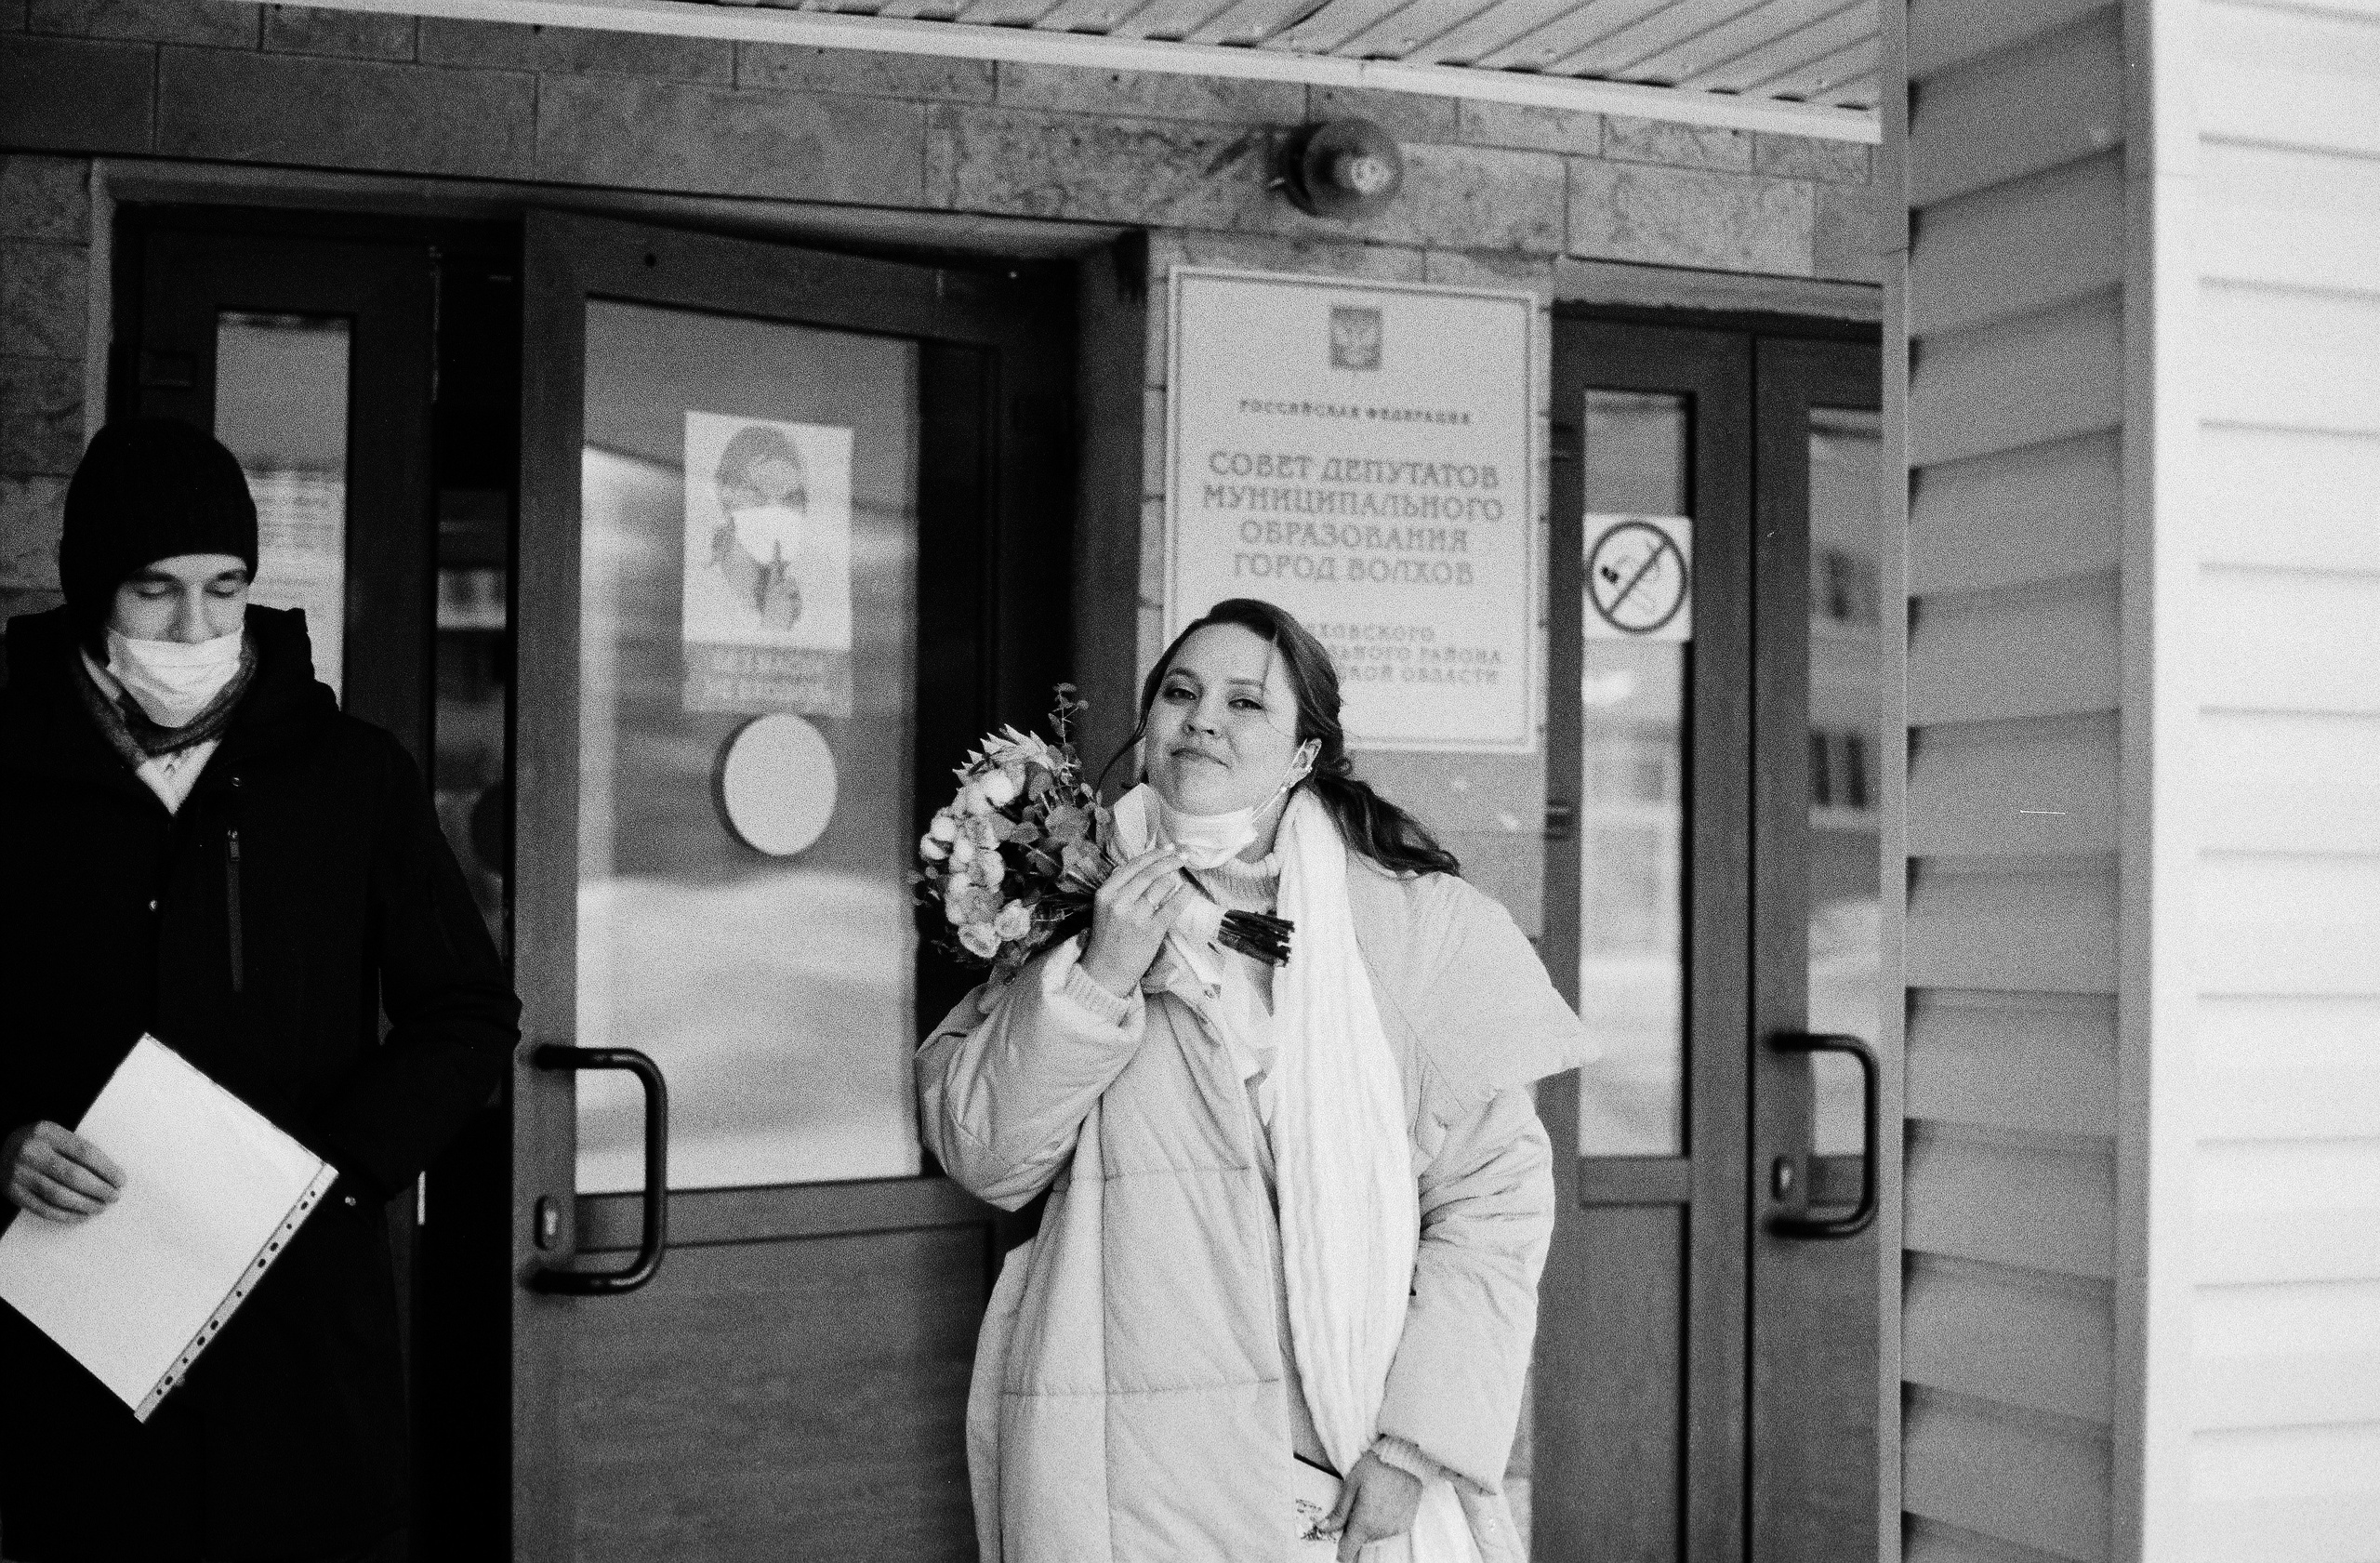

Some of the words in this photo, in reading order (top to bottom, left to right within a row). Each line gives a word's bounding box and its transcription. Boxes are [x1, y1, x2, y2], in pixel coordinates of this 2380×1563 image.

[1208, 450, 1314, 479] СОВЕТ
[1321, 457, 1501, 490] ДЕПУТАТОВ
[1202, 484, 1504, 522] МУНИЦИПАЛЬНОГО
[1238, 519, 1469, 552] ОБРАЗОВАНИЯ
[1234, 552, 1337, 582] ГОРОД
[1346, 557, 1474, 587] ВОЛХОВ
